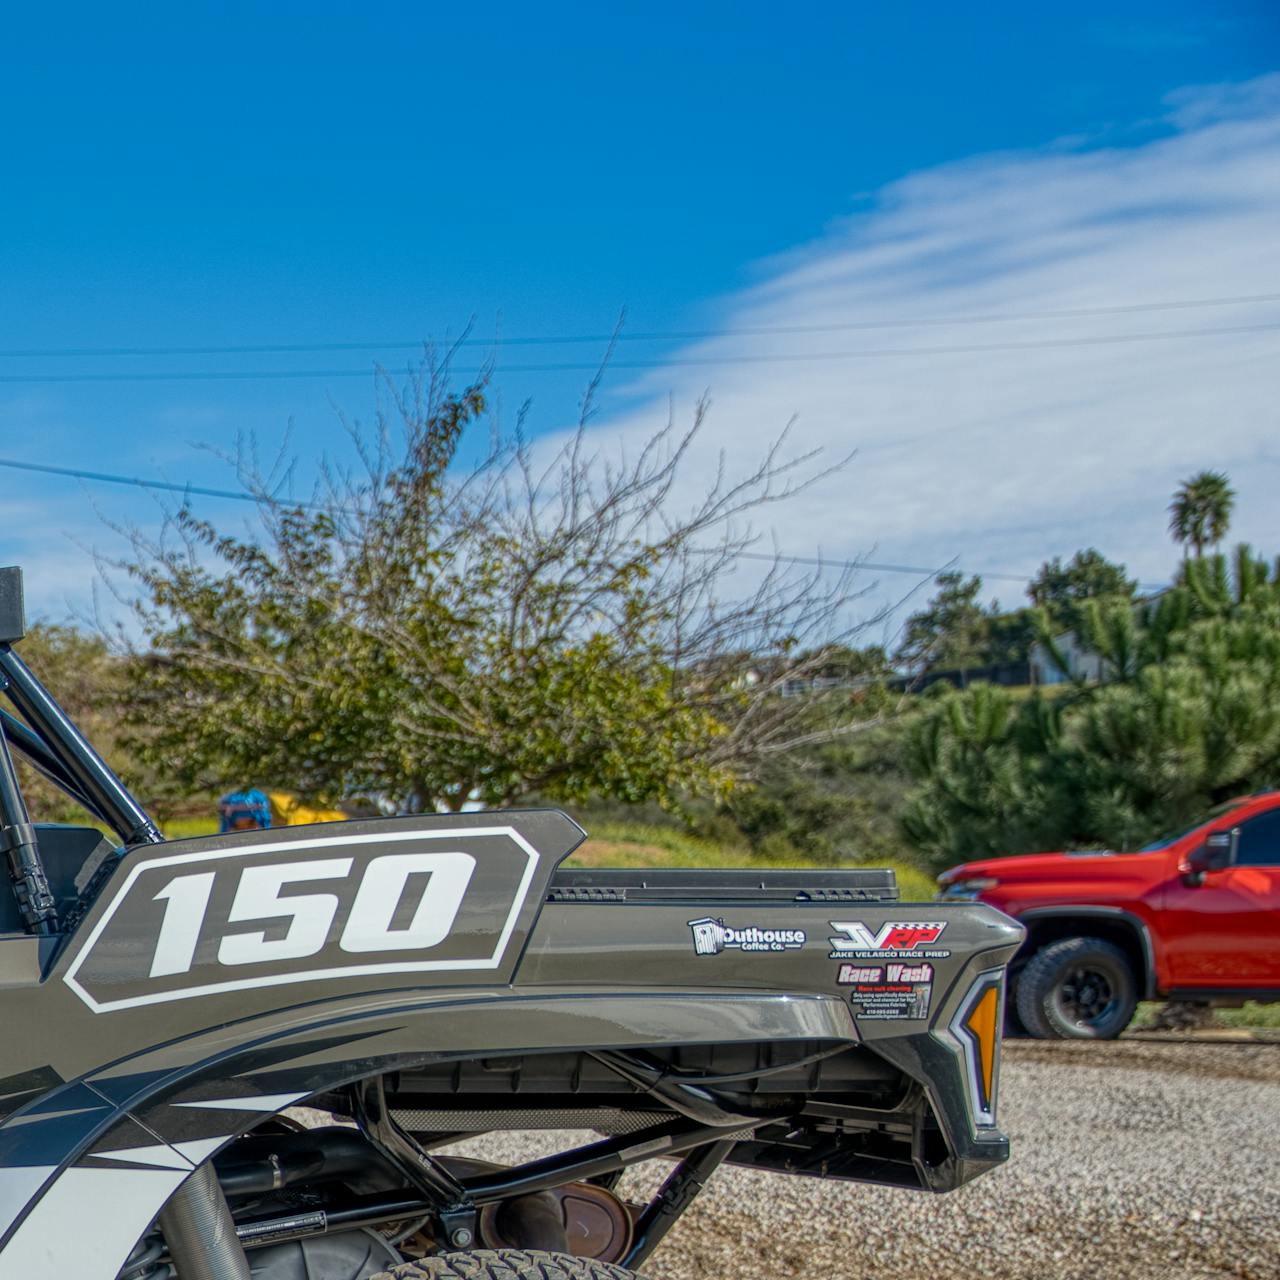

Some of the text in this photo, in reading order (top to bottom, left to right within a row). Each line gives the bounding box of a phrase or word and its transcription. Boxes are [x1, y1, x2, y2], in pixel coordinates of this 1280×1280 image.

[149, 852, 477, 978] 150
[723, 928, 805, 943] Outhouse
[741, 943, 785, 951] Coffee Co.
[839, 963, 933, 982] Race Wash
